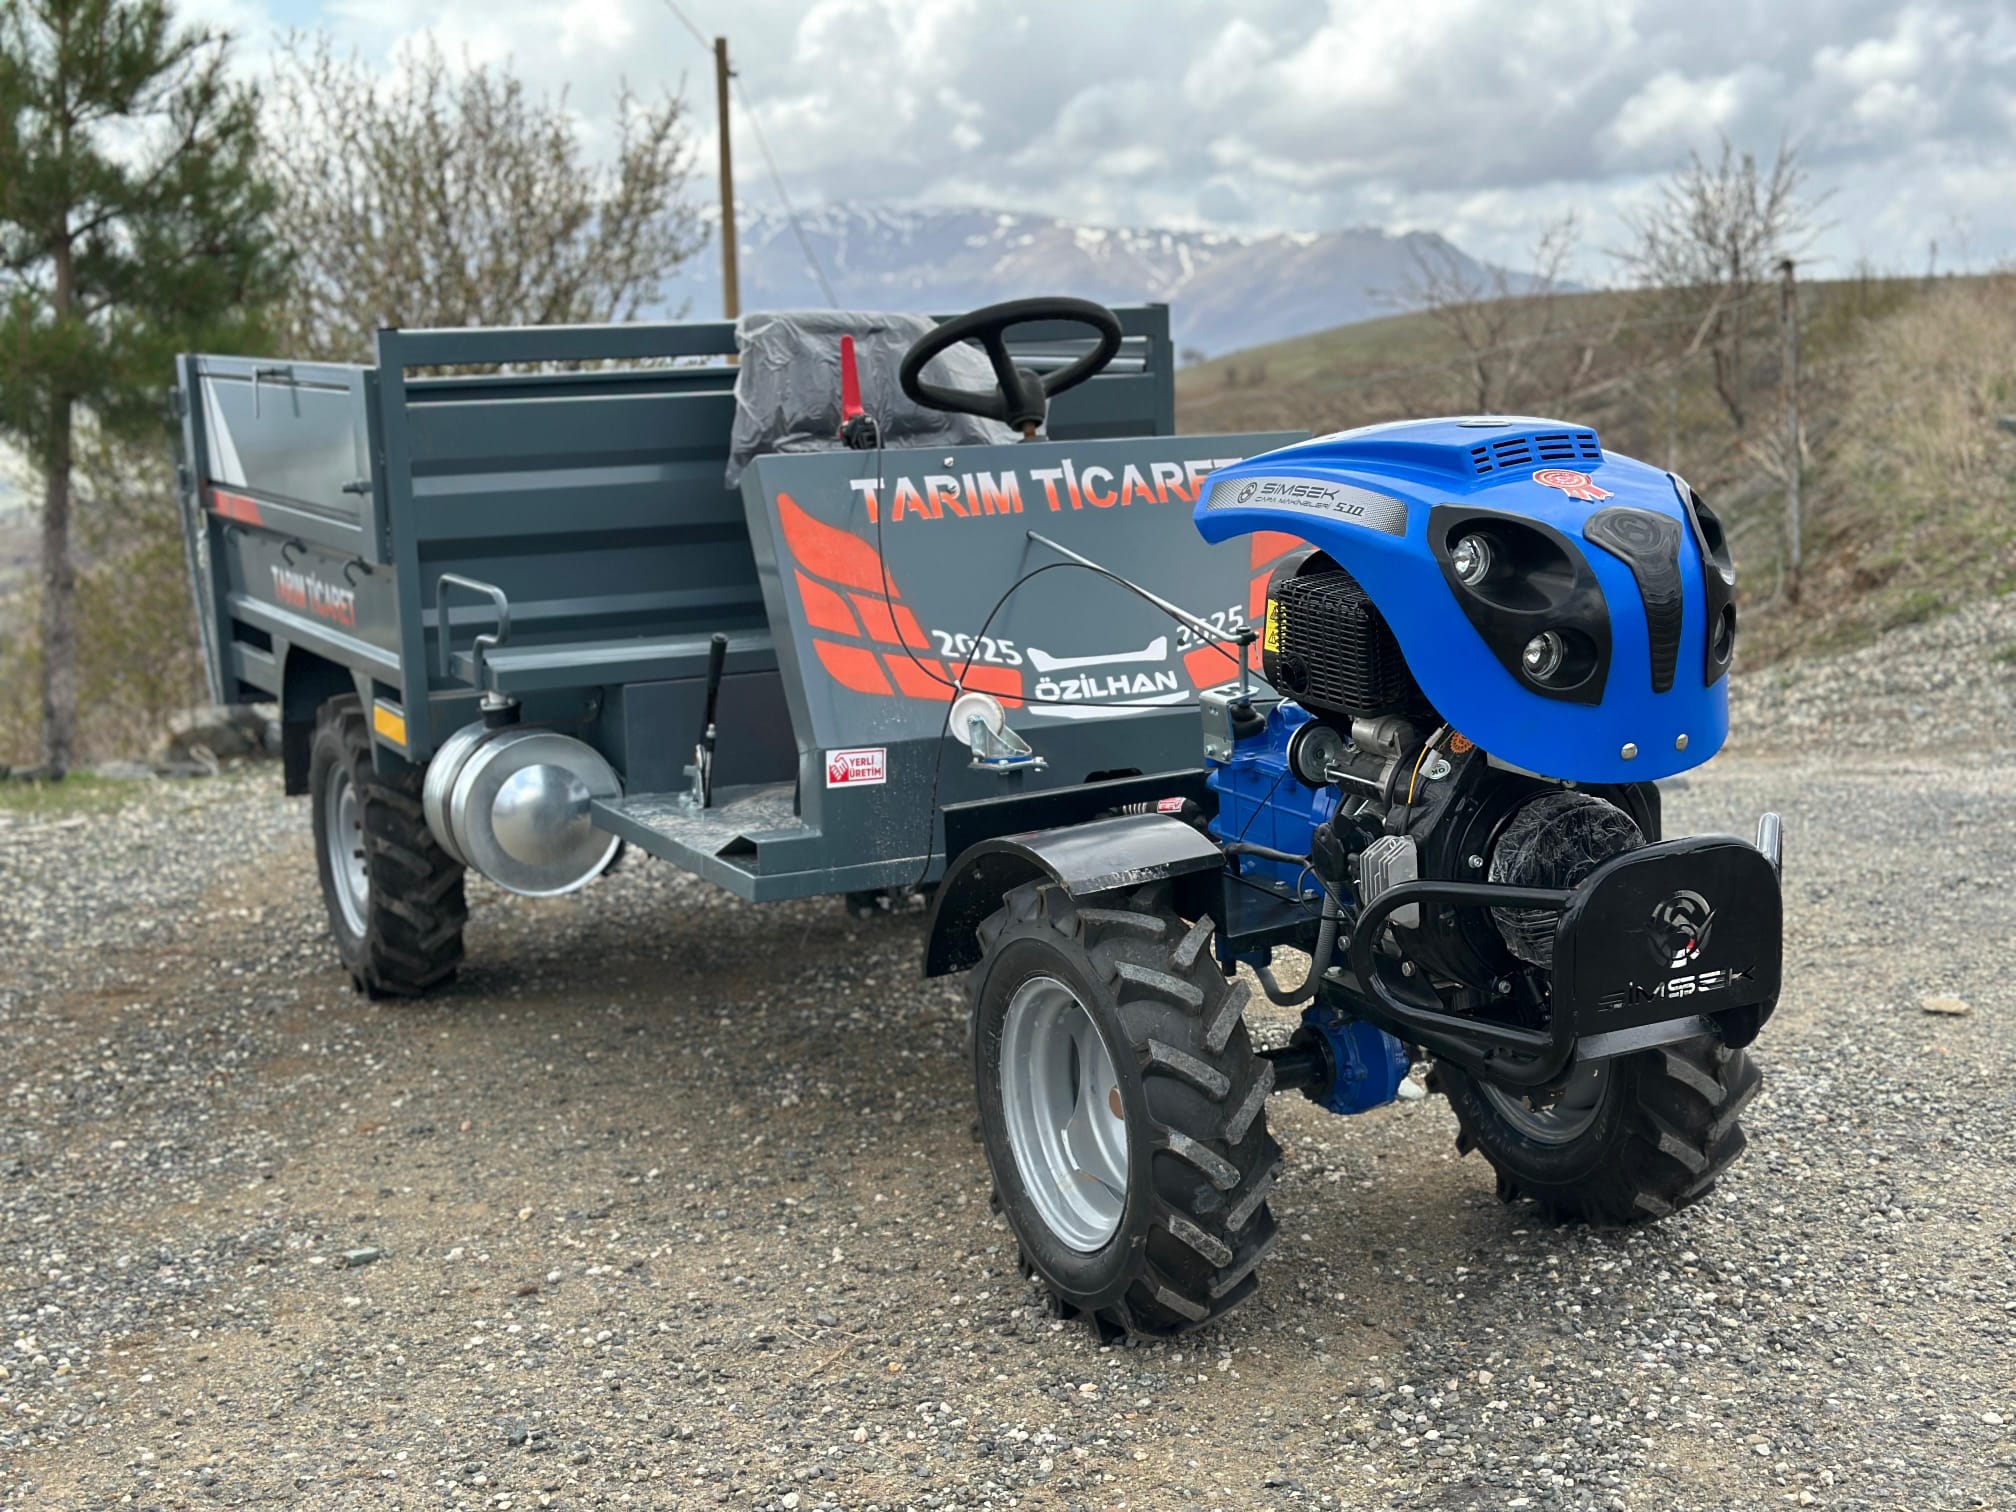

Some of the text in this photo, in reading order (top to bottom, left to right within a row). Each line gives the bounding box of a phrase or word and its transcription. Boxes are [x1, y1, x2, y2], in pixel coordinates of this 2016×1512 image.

[849, 468, 1023, 524] TARIM
[931, 629, 1023, 665] 2025
[1034, 670, 1178, 701] ÖZİLHAN
